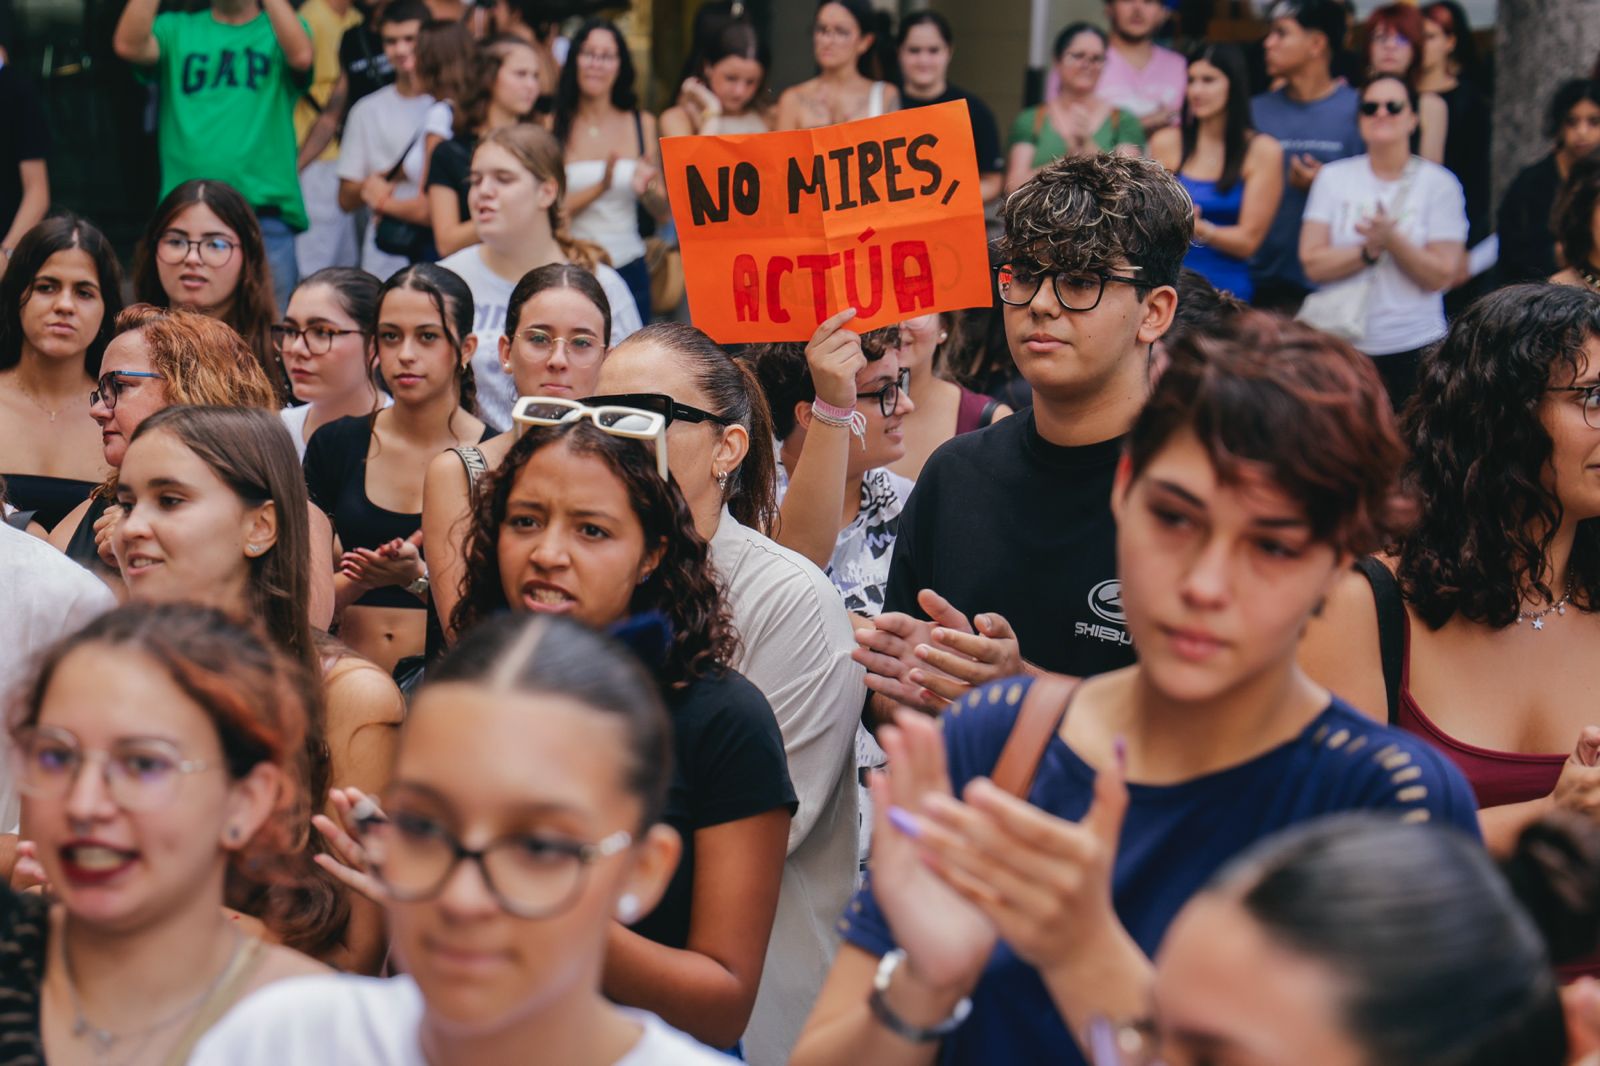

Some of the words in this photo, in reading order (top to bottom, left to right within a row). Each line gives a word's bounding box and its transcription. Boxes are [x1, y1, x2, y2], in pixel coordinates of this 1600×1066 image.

[182, 47, 272, 95] GAP
[686, 161, 760, 226] NO
[787, 133, 960, 215] MIRES,
[732, 226, 935, 326] ACTÚA
[1074, 621, 1133, 645] SHIBU
